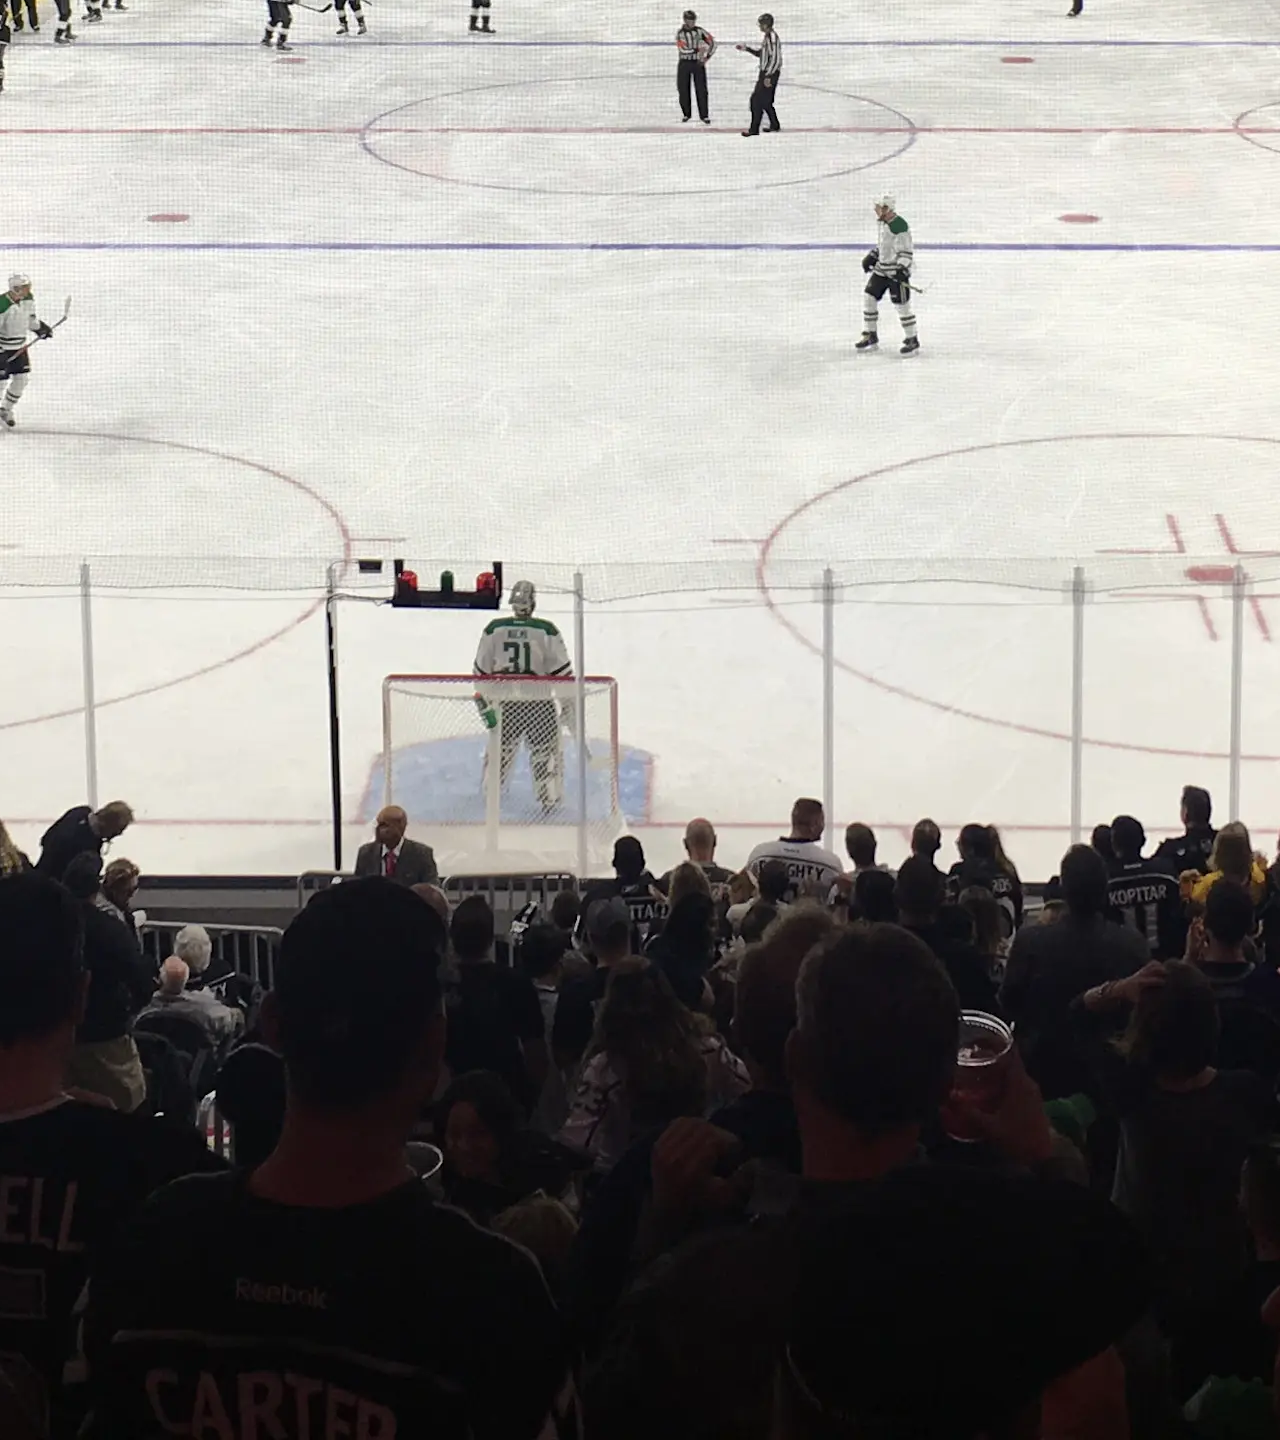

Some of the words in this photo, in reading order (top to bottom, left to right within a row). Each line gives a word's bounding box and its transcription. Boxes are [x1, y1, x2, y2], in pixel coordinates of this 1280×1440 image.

[504, 642, 530, 674] 31
[1108, 885, 1167, 906] KOPITAR
[235, 1276, 328, 1310] Reebok
[144, 1367, 398, 1440] CARTER
